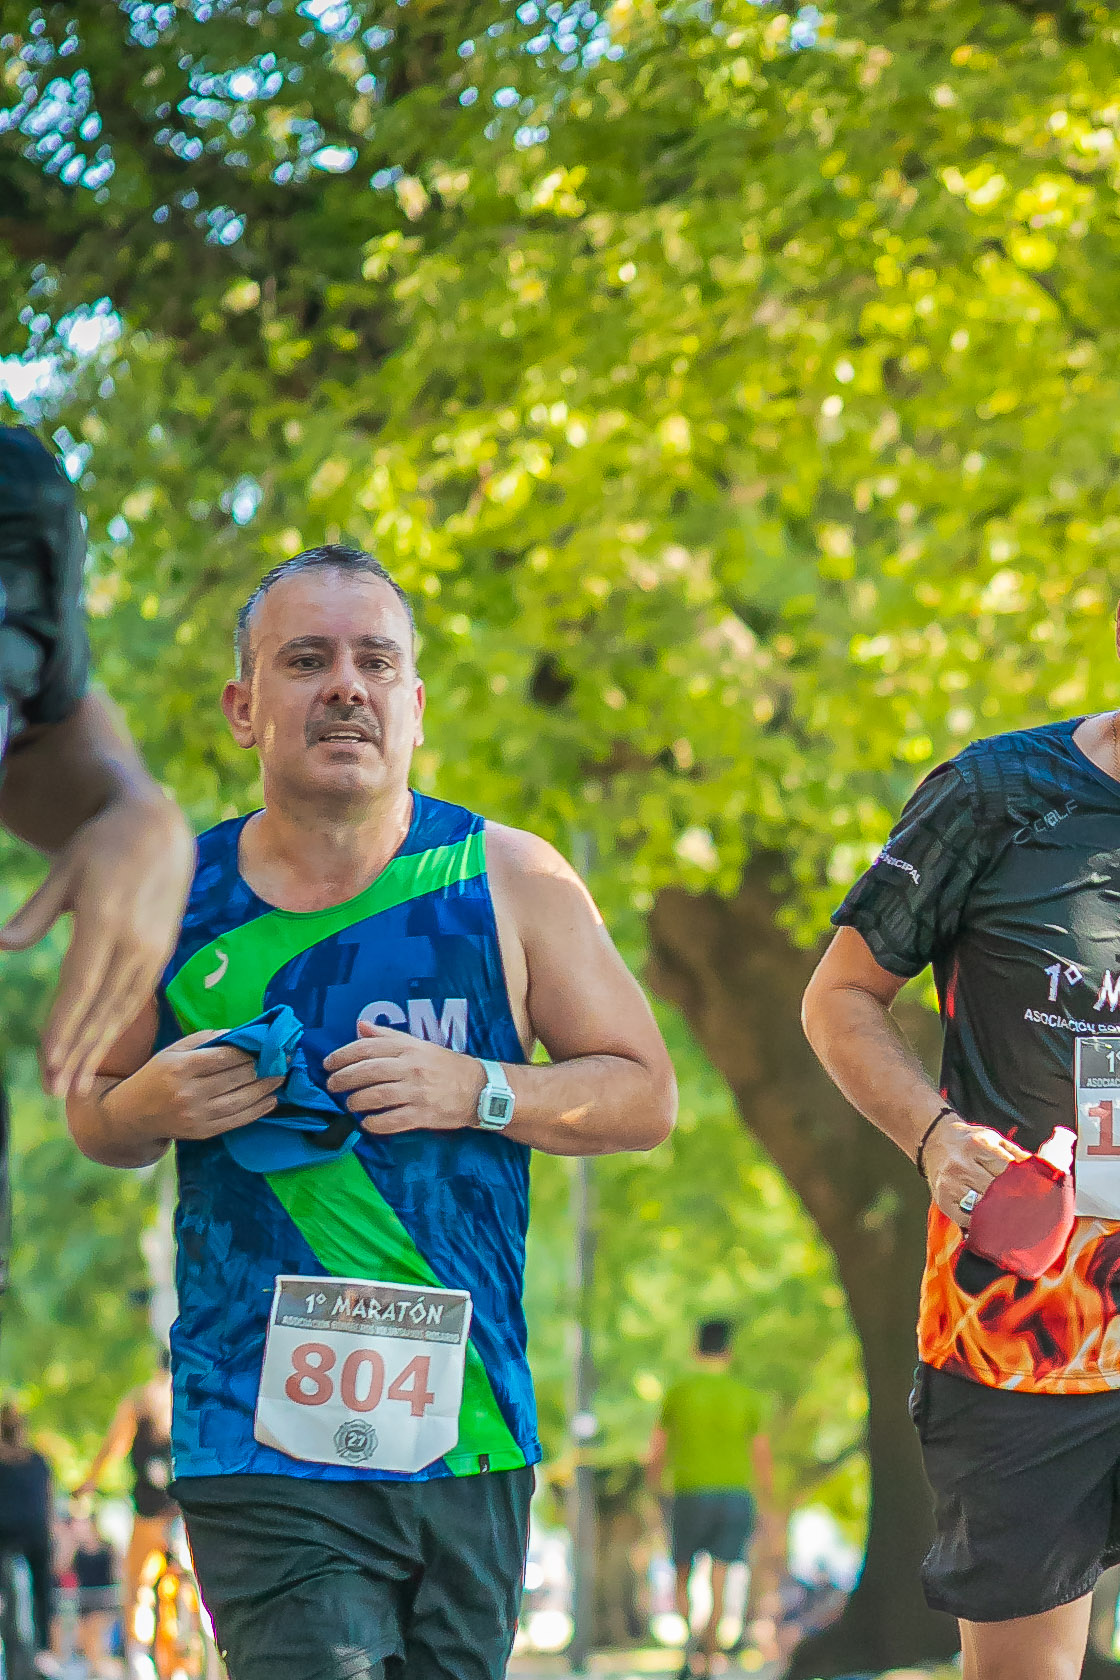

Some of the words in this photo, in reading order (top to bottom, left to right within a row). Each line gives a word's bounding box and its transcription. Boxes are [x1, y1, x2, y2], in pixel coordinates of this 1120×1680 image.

[331, 1295, 444, 1326] MARATÓN
[284, 1342, 435, 1418] 804
[347, 1431, 366, 1448] 27
